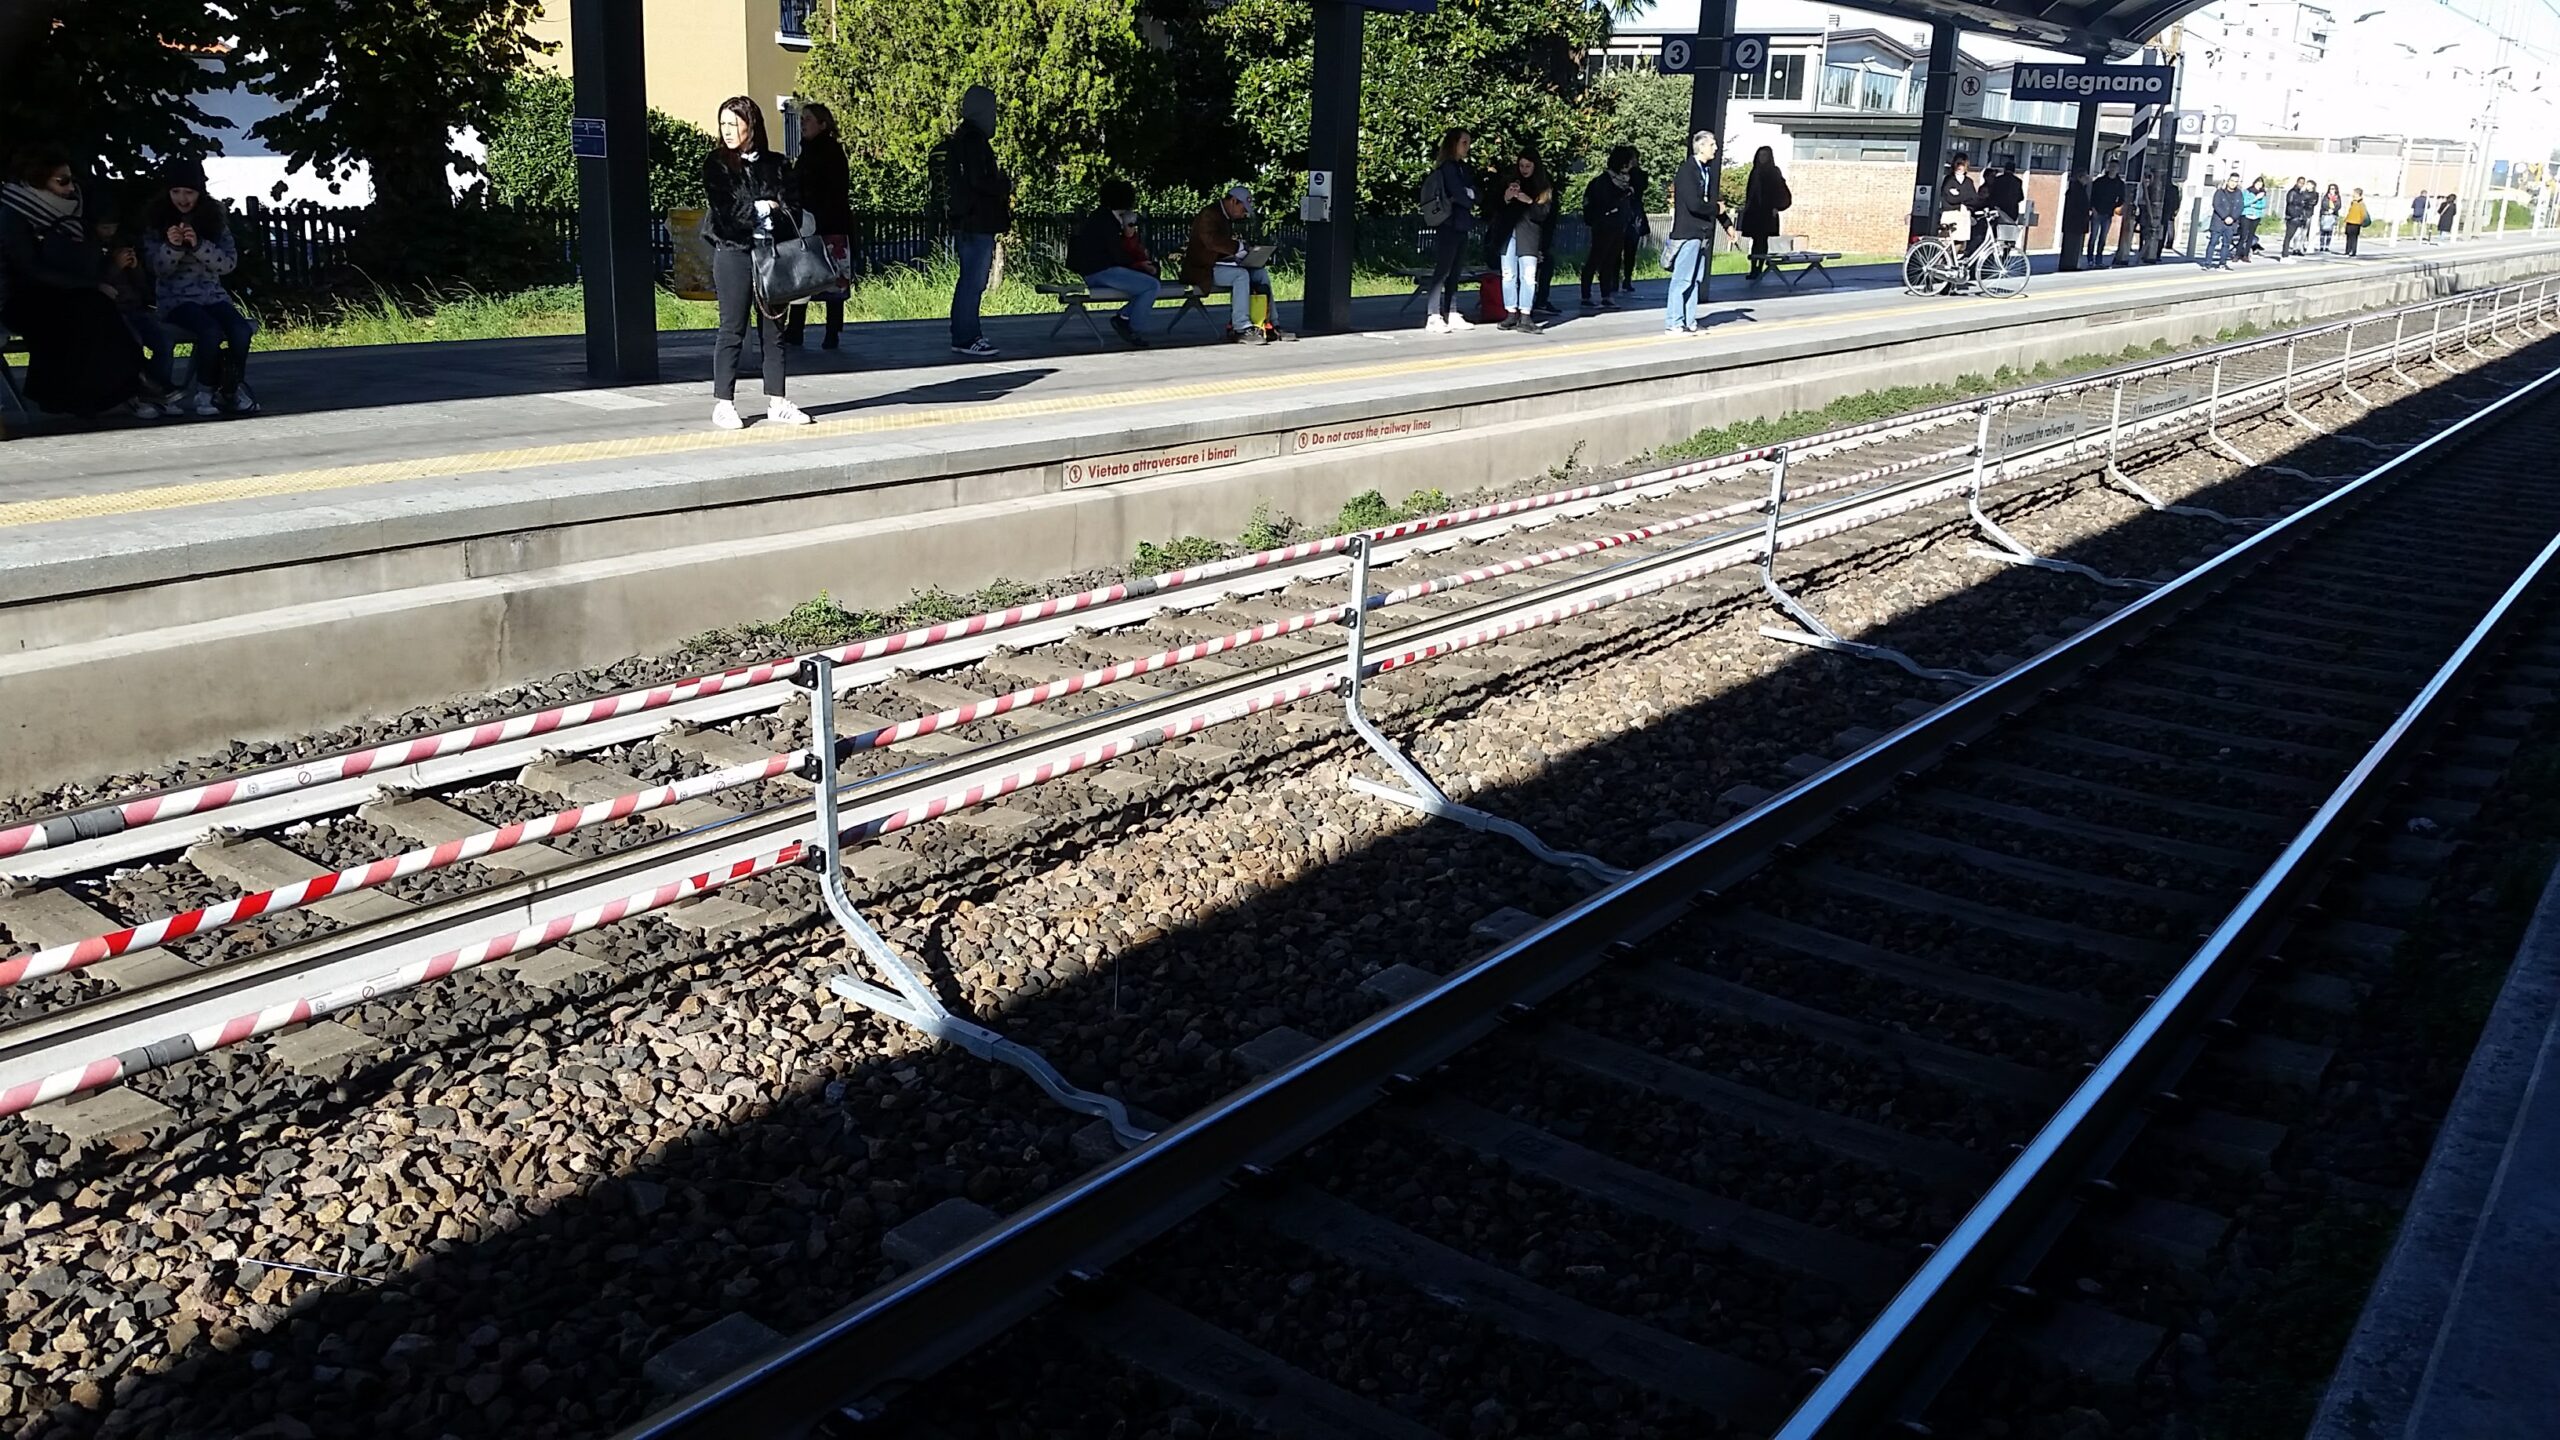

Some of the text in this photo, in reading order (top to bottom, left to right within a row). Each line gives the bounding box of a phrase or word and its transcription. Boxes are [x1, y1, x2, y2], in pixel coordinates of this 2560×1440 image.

[1670, 44, 1684, 65] 3
[1742, 44, 1756, 64] 2
[2017, 69, 2163, 96] Melegnano
[1311, 419, 1432, 445] Do not cross the railway lines
[1088, 445, 1238, 479] Vietato attraversare i binari
